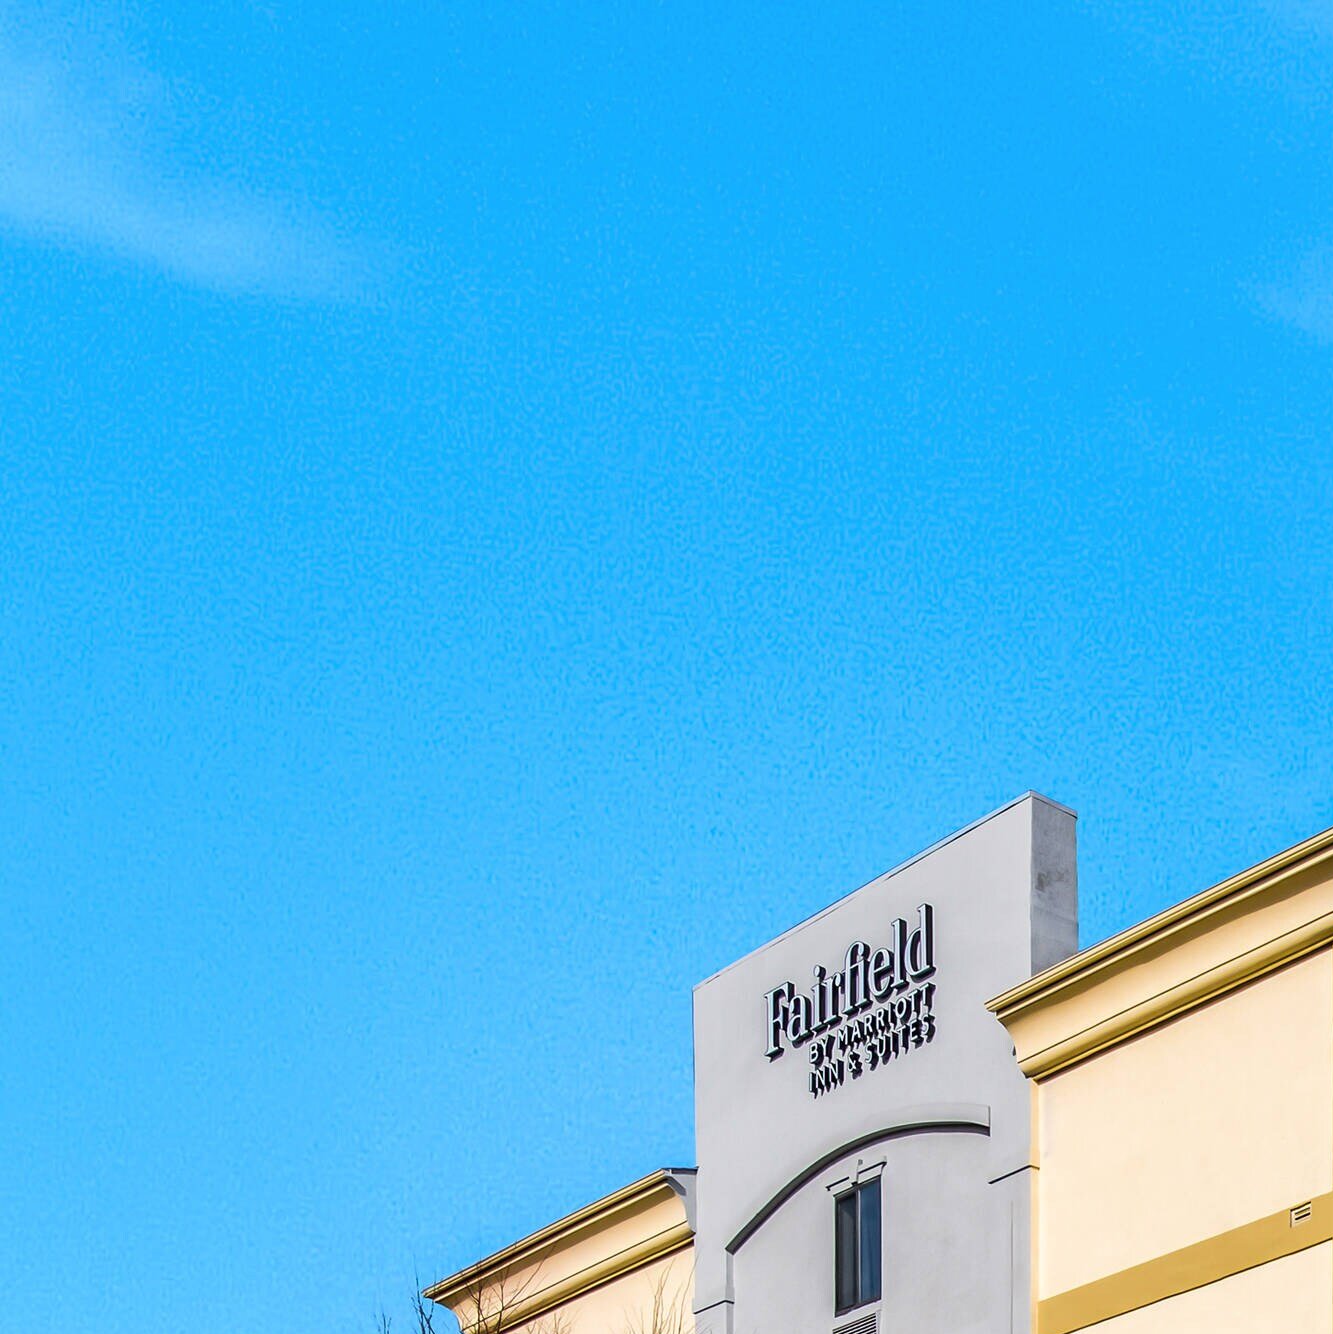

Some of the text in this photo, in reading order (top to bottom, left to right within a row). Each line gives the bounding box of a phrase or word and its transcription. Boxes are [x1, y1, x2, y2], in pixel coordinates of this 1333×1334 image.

[764, 903, 937, 1063] Fairfield
[809, 982, 936, 1069] BY MARRIOTT
[809, 1058, 844, 1096] INN
[865, 1014, 936, 1070] SUITES
